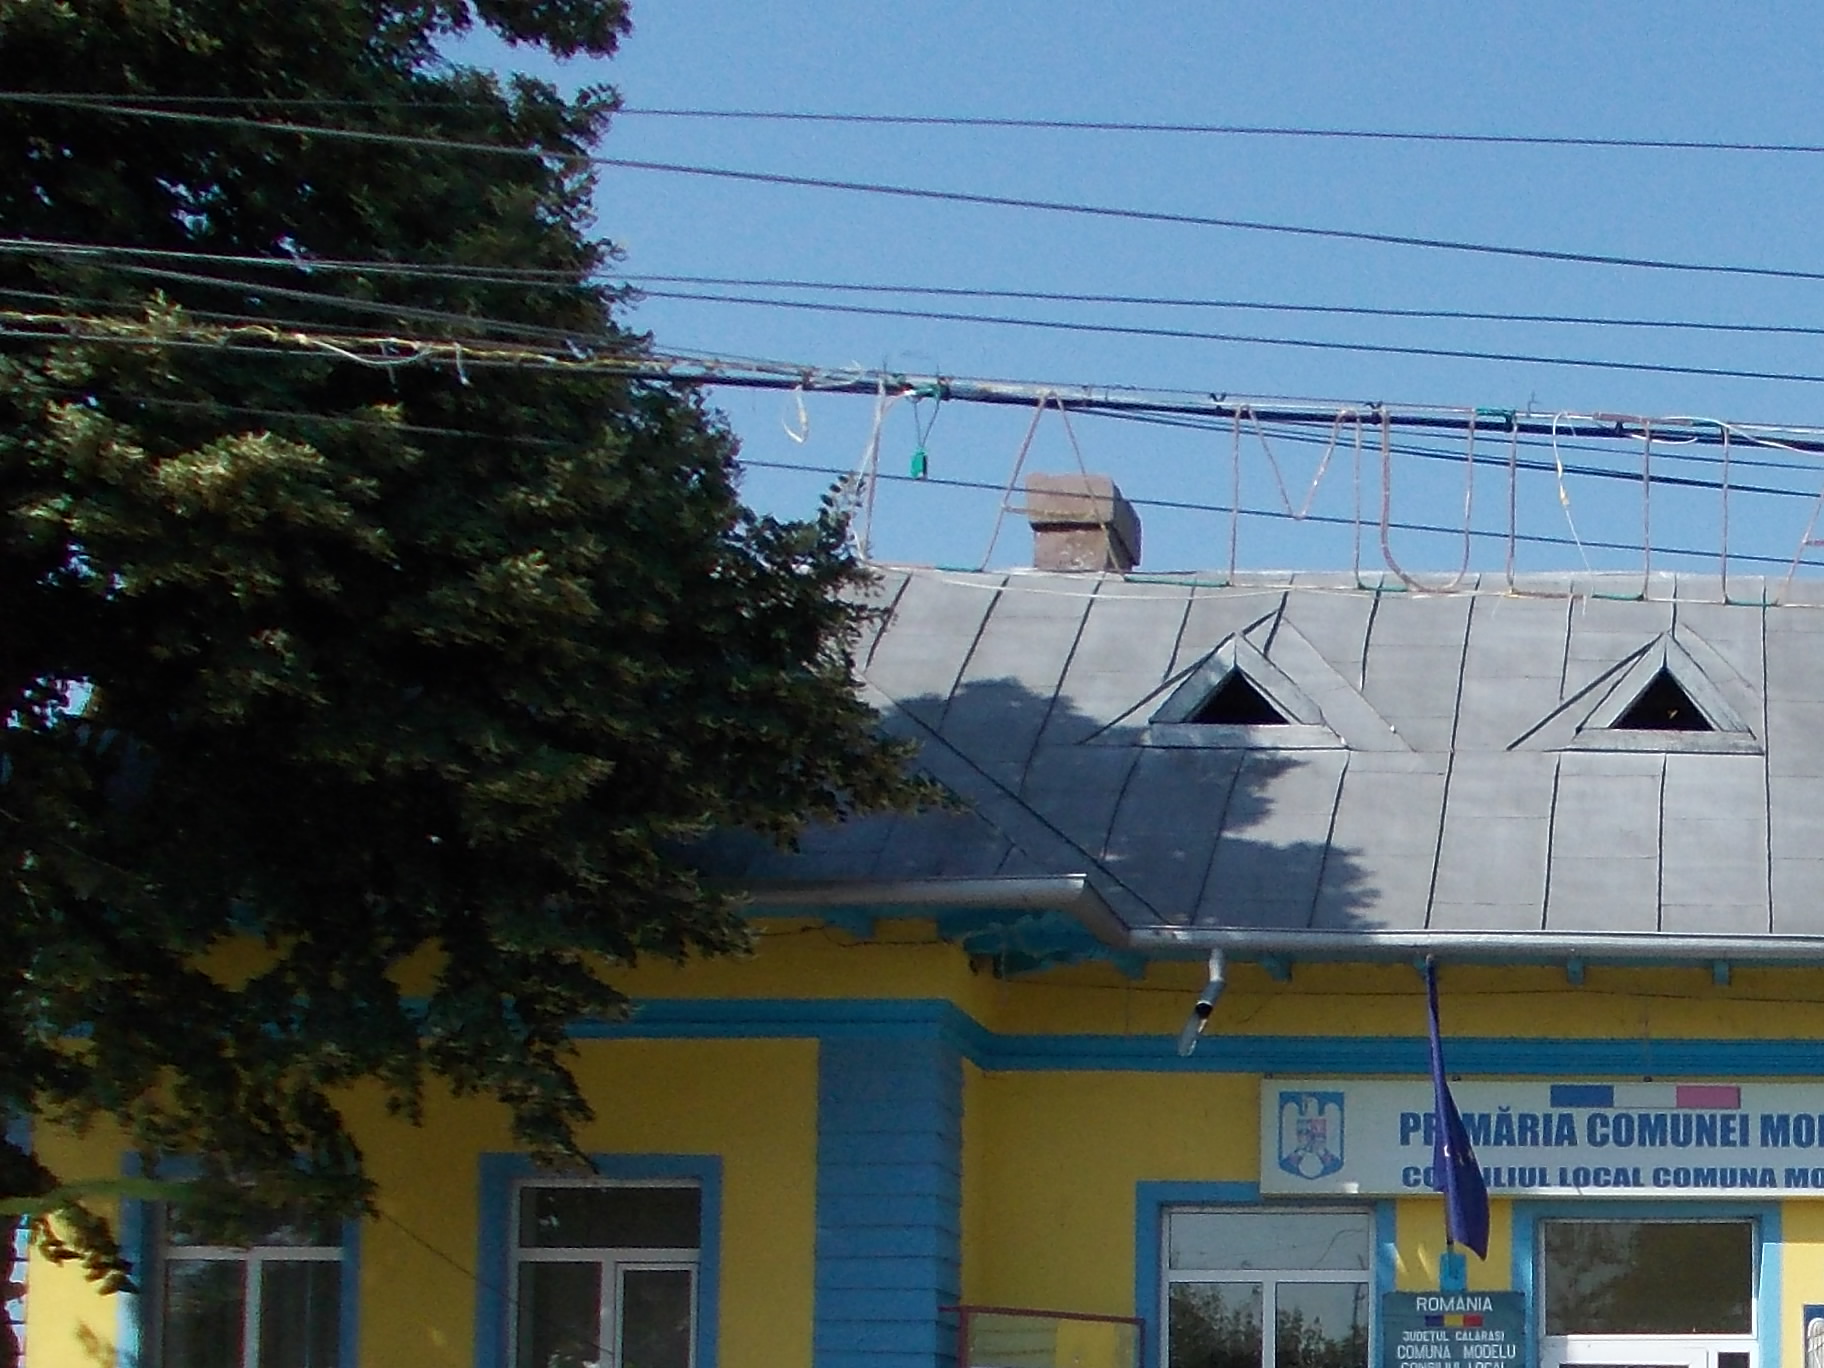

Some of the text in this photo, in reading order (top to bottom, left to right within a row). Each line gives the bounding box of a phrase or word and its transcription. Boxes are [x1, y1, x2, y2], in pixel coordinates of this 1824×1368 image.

[1586, 1112, 1750, 1148] COMUNEI
[1559, 1167, 1645, 1188] LOCAL
[1652, 1167, 1777, 1188] COMUNA
[1397, 1344, 1516, 1360] COMUNA MODELU
